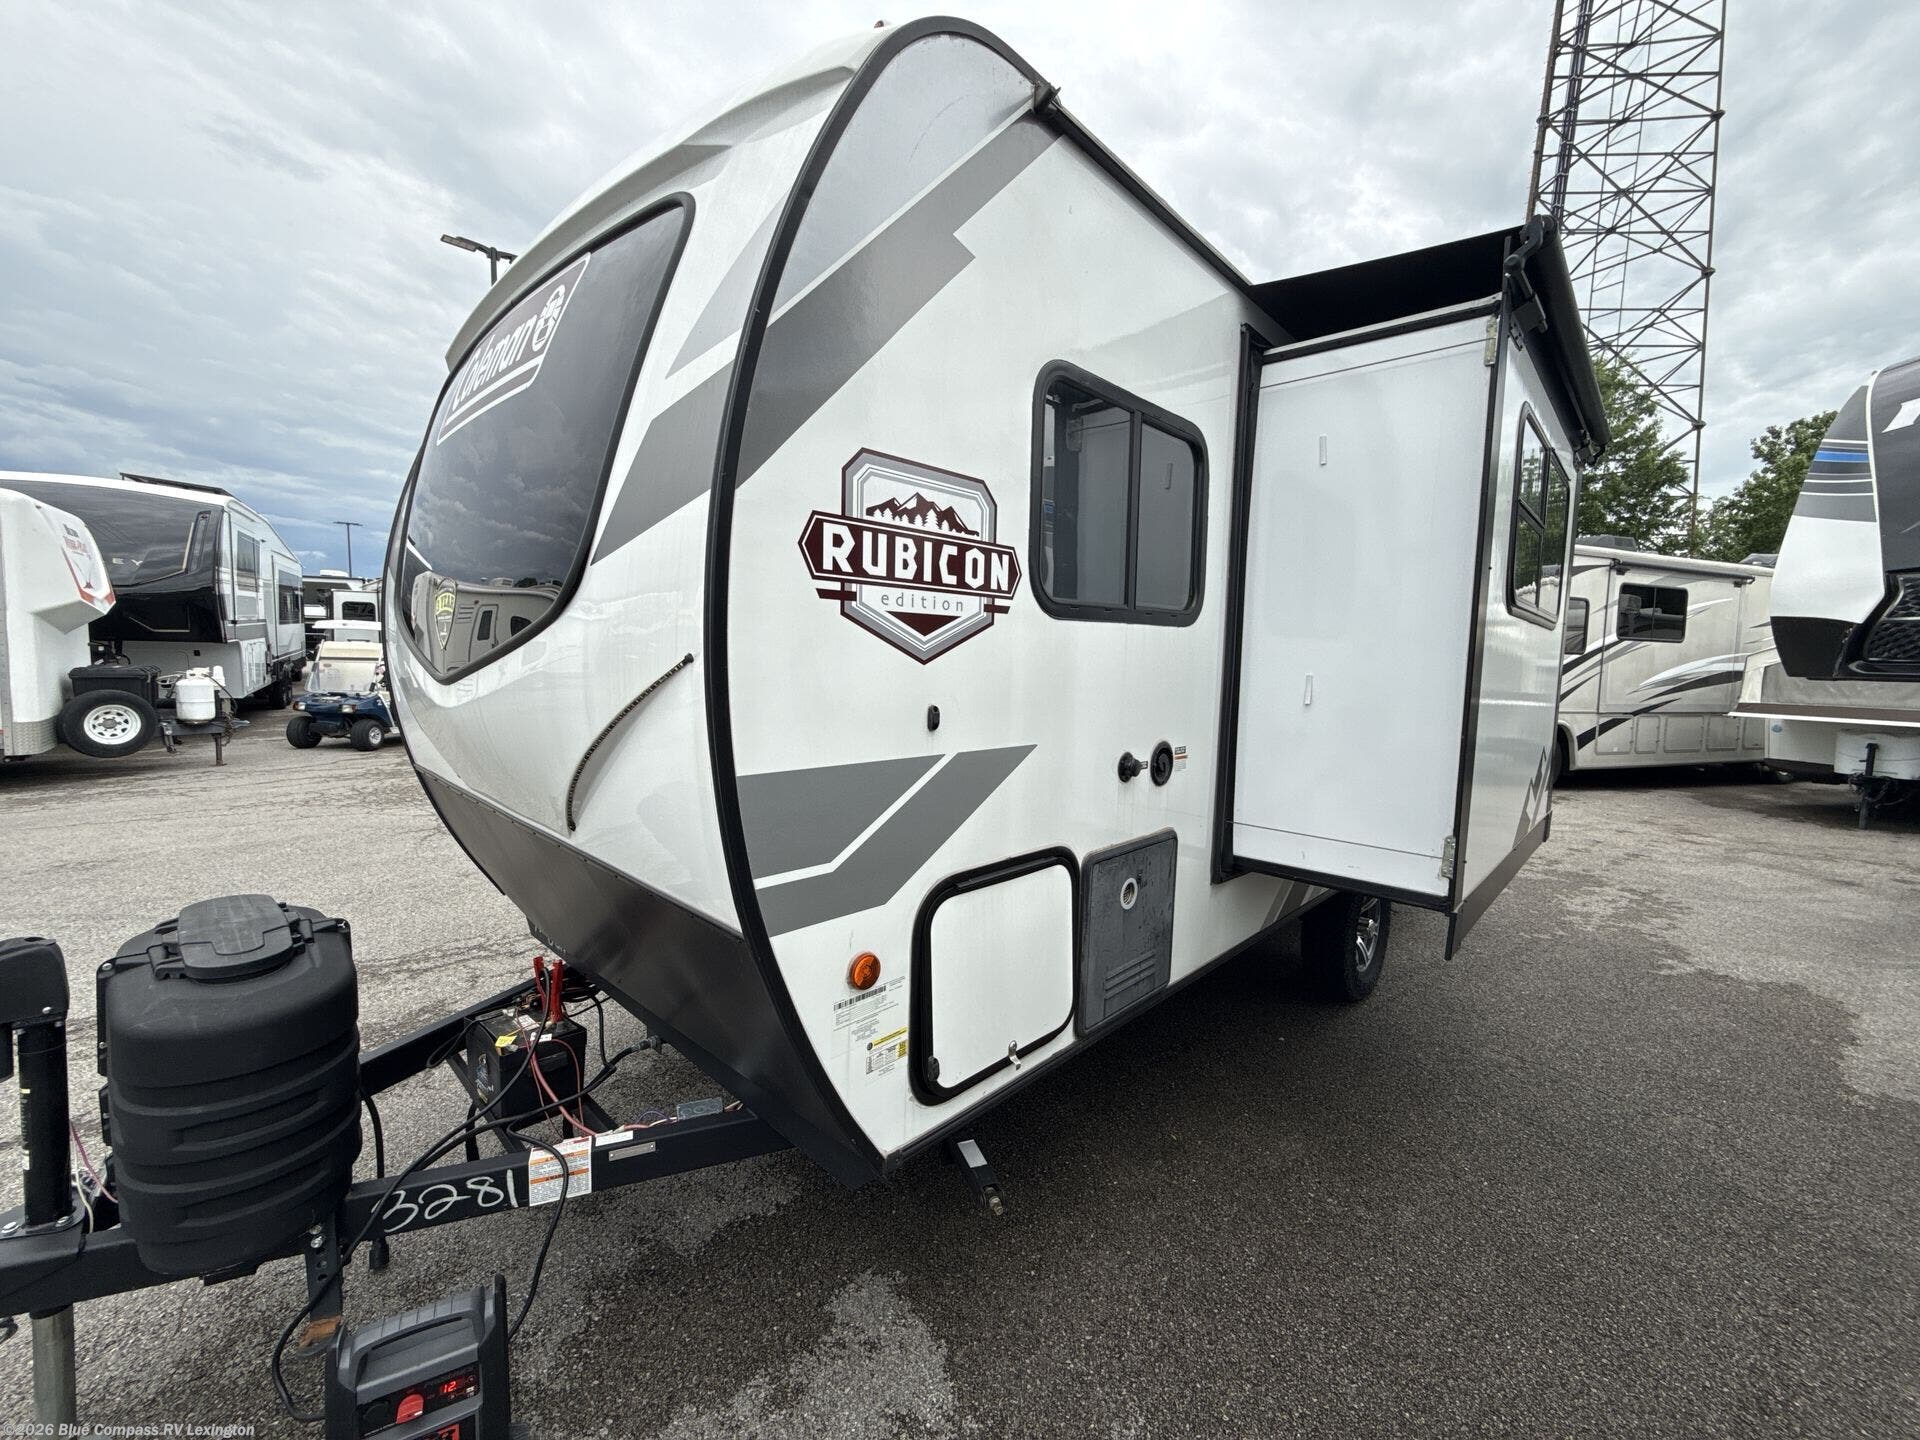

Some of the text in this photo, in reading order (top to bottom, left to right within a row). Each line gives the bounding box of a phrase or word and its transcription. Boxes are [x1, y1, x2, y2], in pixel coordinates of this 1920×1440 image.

[452, 313, 538, 412] Coleman
[822, 521, 1010, 592] RUBICON
[880, 592, 964, 612] edition
[370, 1168, 519, 1233] 3281
